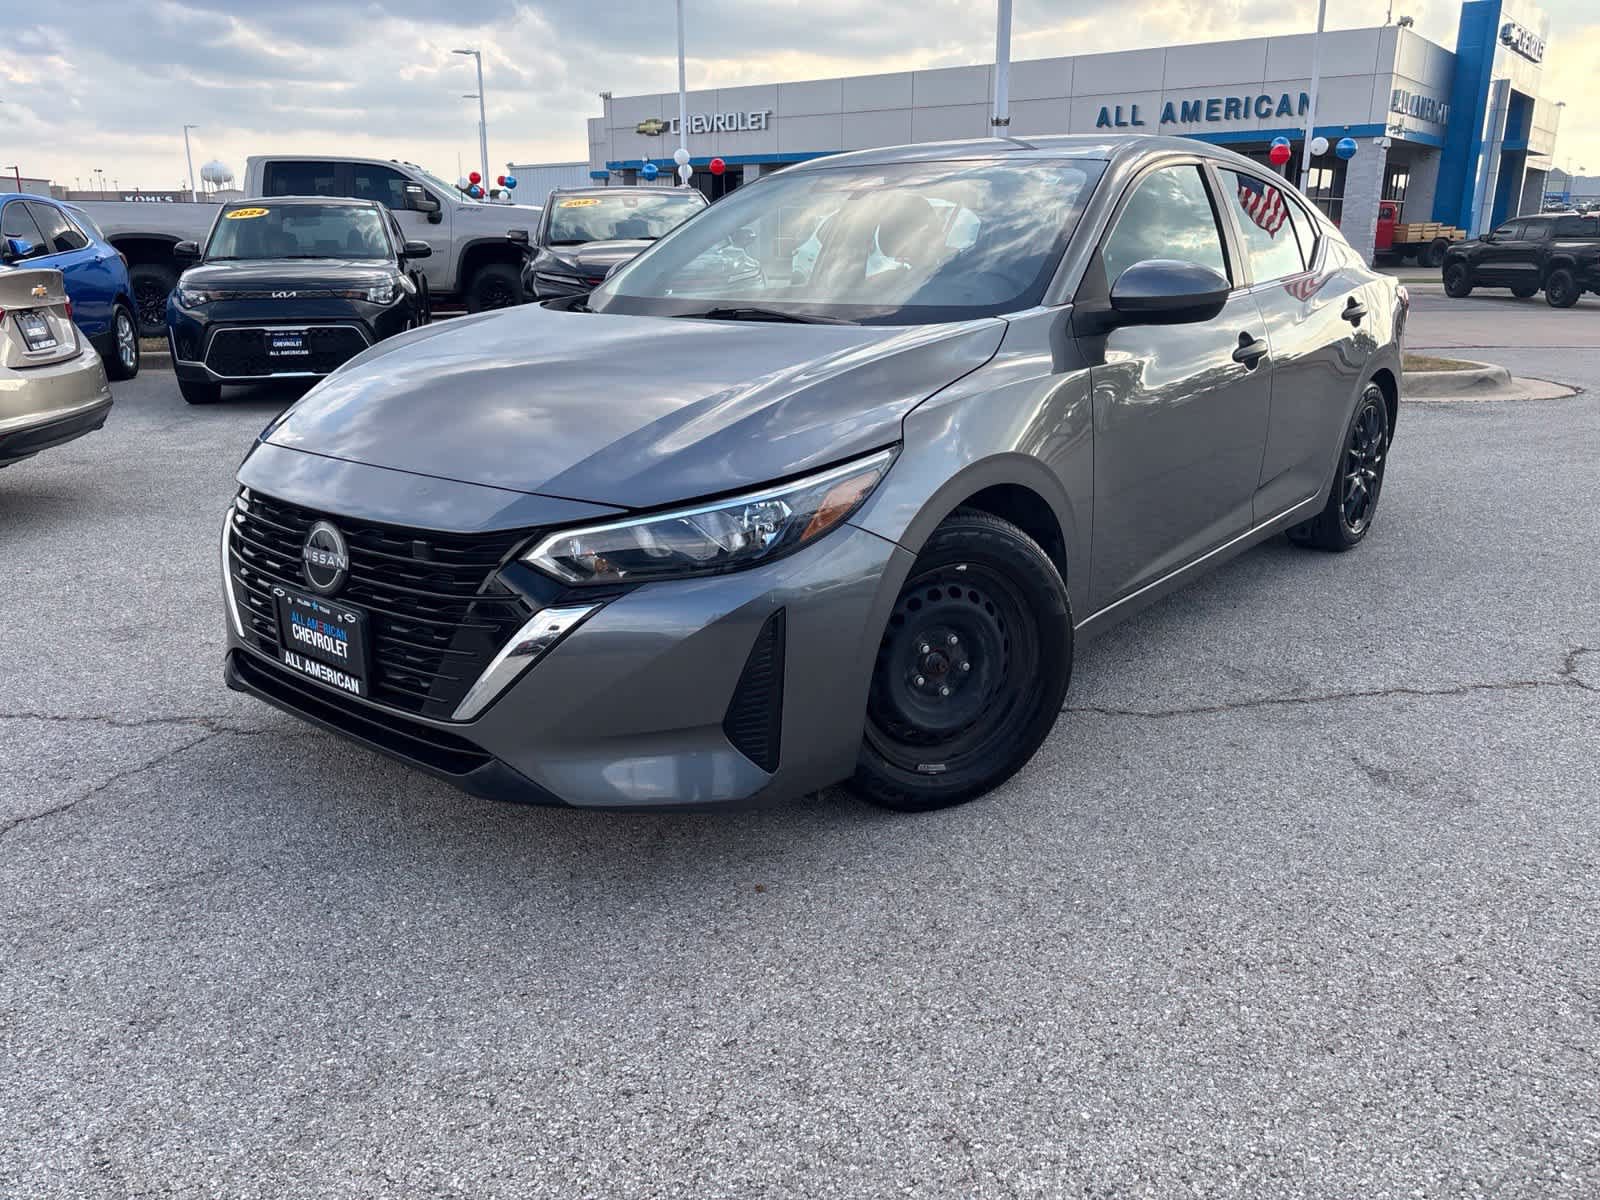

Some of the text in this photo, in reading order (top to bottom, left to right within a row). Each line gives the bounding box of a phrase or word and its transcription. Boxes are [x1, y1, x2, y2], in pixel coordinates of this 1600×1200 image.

[1096, 104, 1145, 127] ALL
[303, 547, 347, 569] NISSAN
[291, 611, 348, 642] ALL AMERICAN
[292, 623, 349, 660] CHEVROLET
[284, 650, 360, 695] ALL AMERICAN
